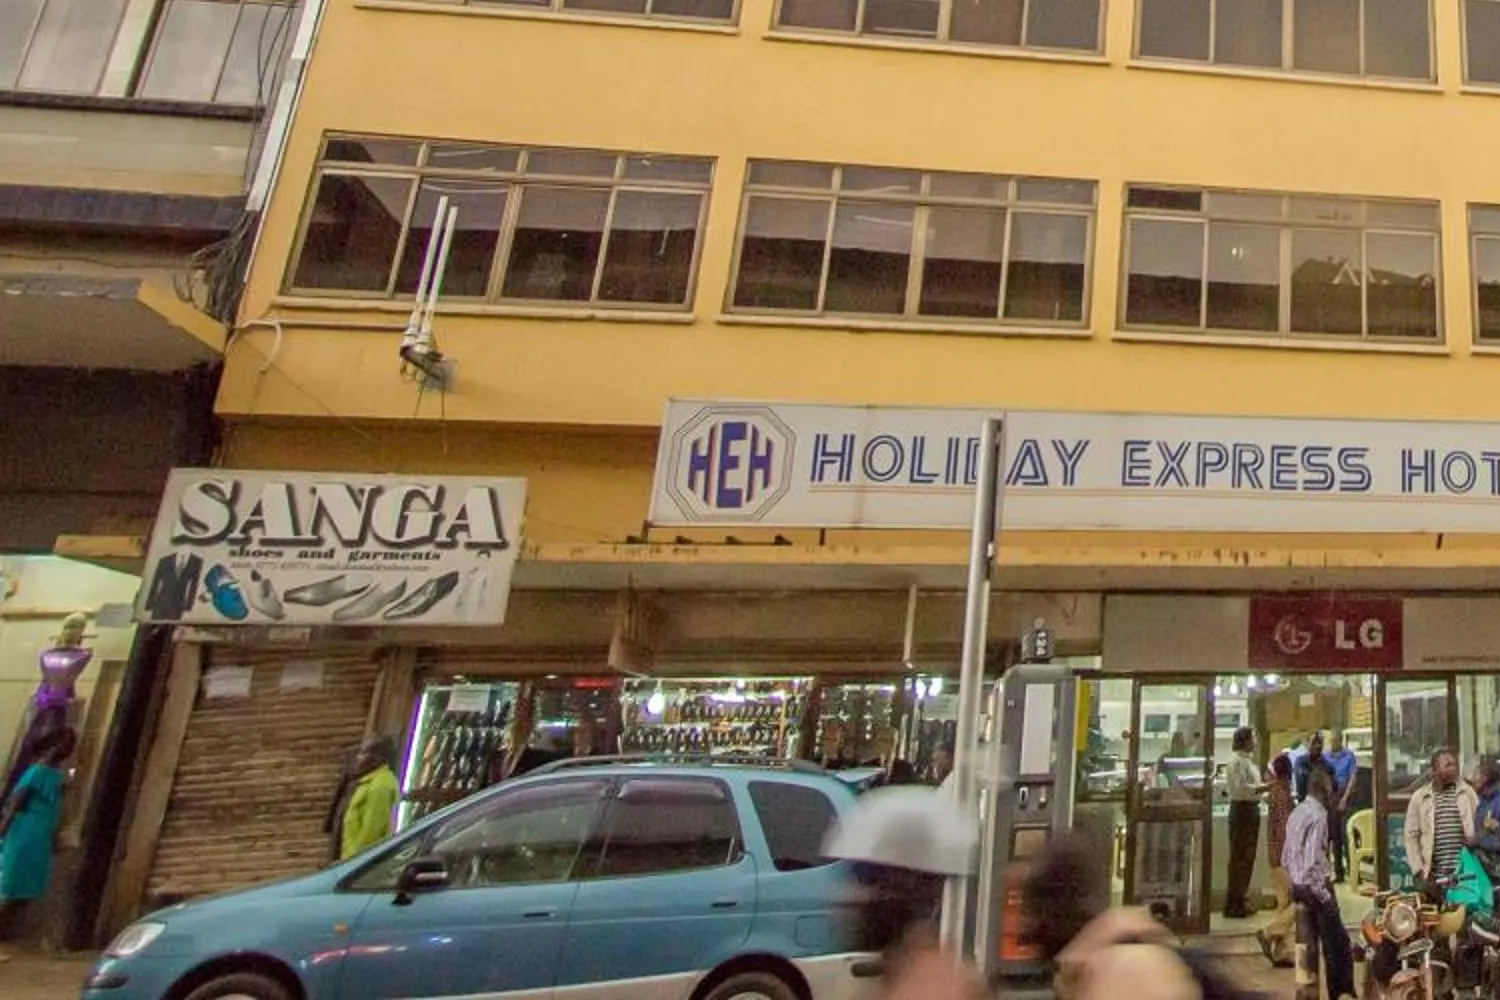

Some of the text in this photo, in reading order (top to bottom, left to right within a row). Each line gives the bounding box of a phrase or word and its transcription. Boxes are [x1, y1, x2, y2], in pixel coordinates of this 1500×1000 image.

[688, 421, 774, 509] HEH
[1120, 440, 1372, 492] EXPRESS
[171, 480, 509, 549] SANGA
[228, 546, 442, 562] shoes and garments
[1335, 619, 1384, 649] LG
